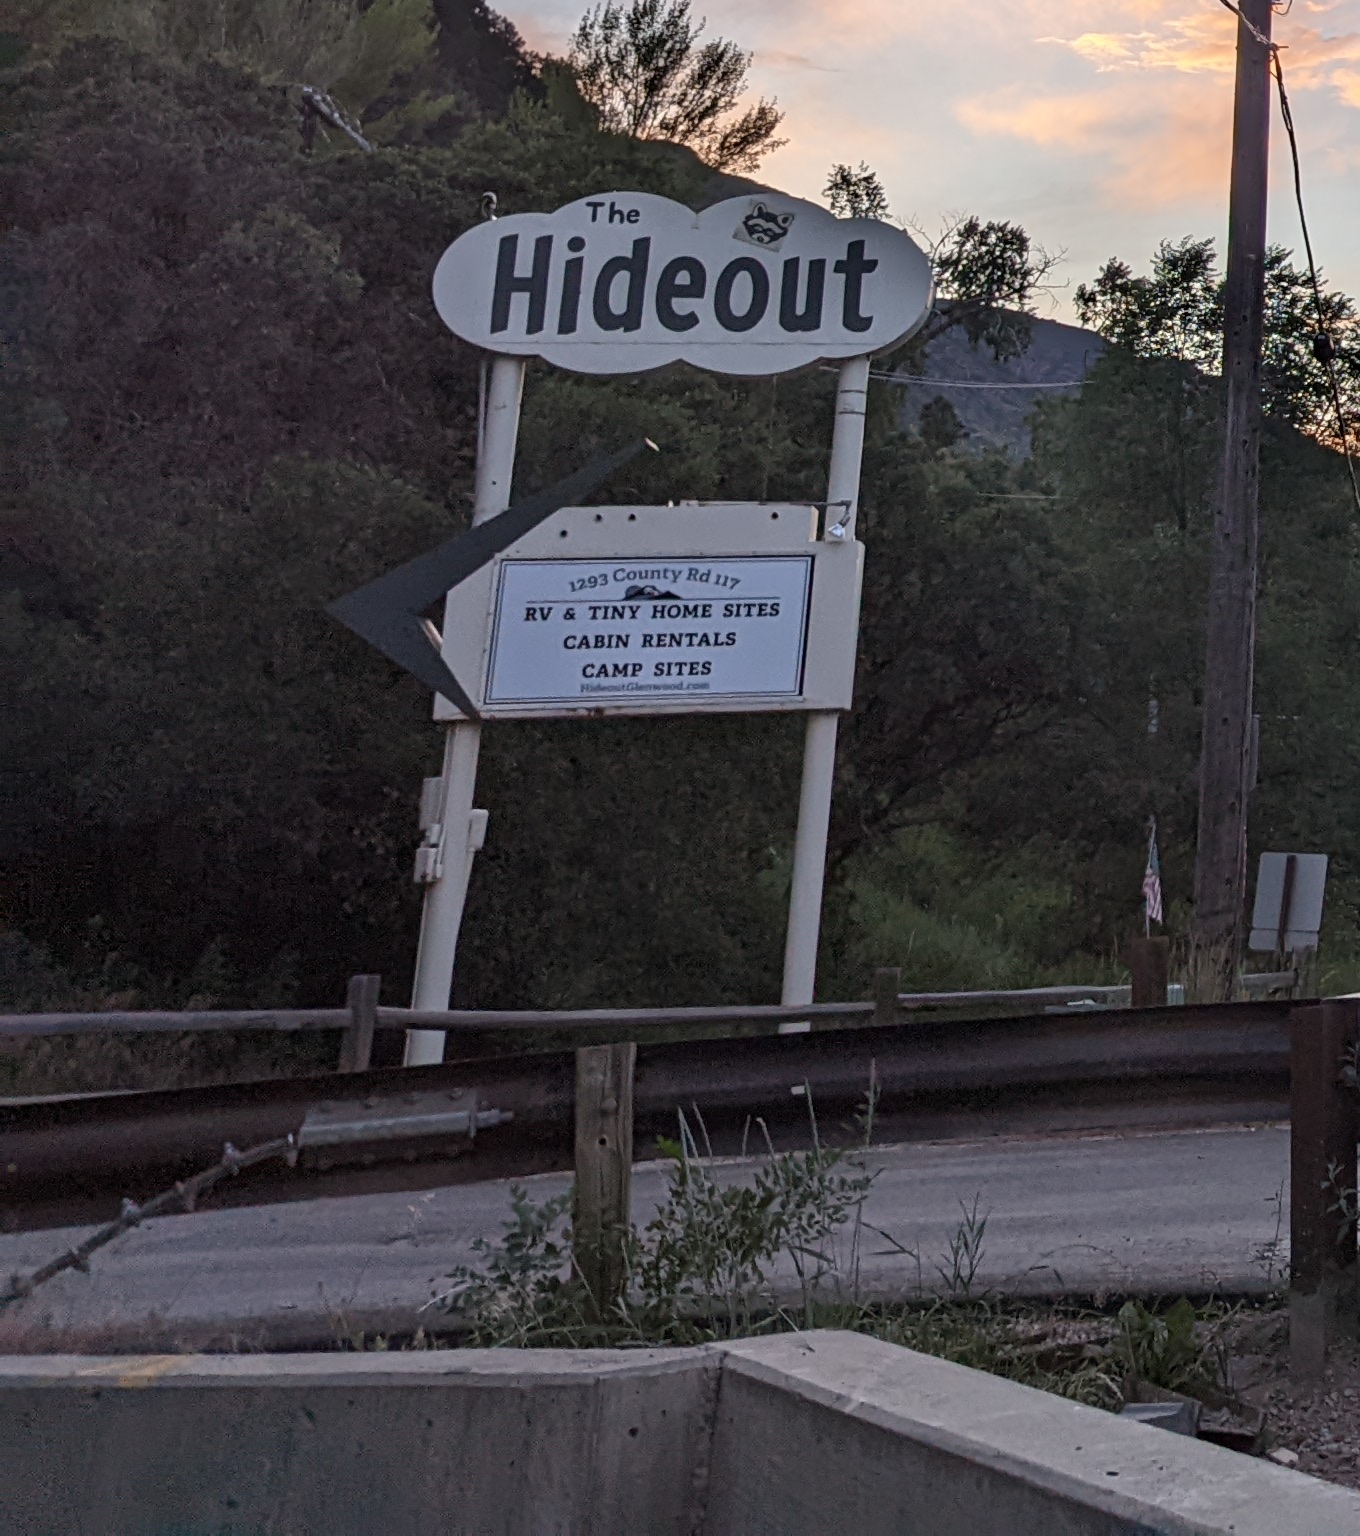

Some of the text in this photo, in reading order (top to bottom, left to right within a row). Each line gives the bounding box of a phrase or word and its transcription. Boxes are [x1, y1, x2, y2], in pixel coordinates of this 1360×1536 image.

[586, 201, 641, 225] The
[489, 232, 879, 336] Hideout
[569, 567, 742, 593] 1293 County Rd 117
[524, 602, 781, 622] RV & TINY HOME SITES
[563, 631, 737, 650] CABIN RENTALS
[582, 661, 713, 679] CAMP SITES
